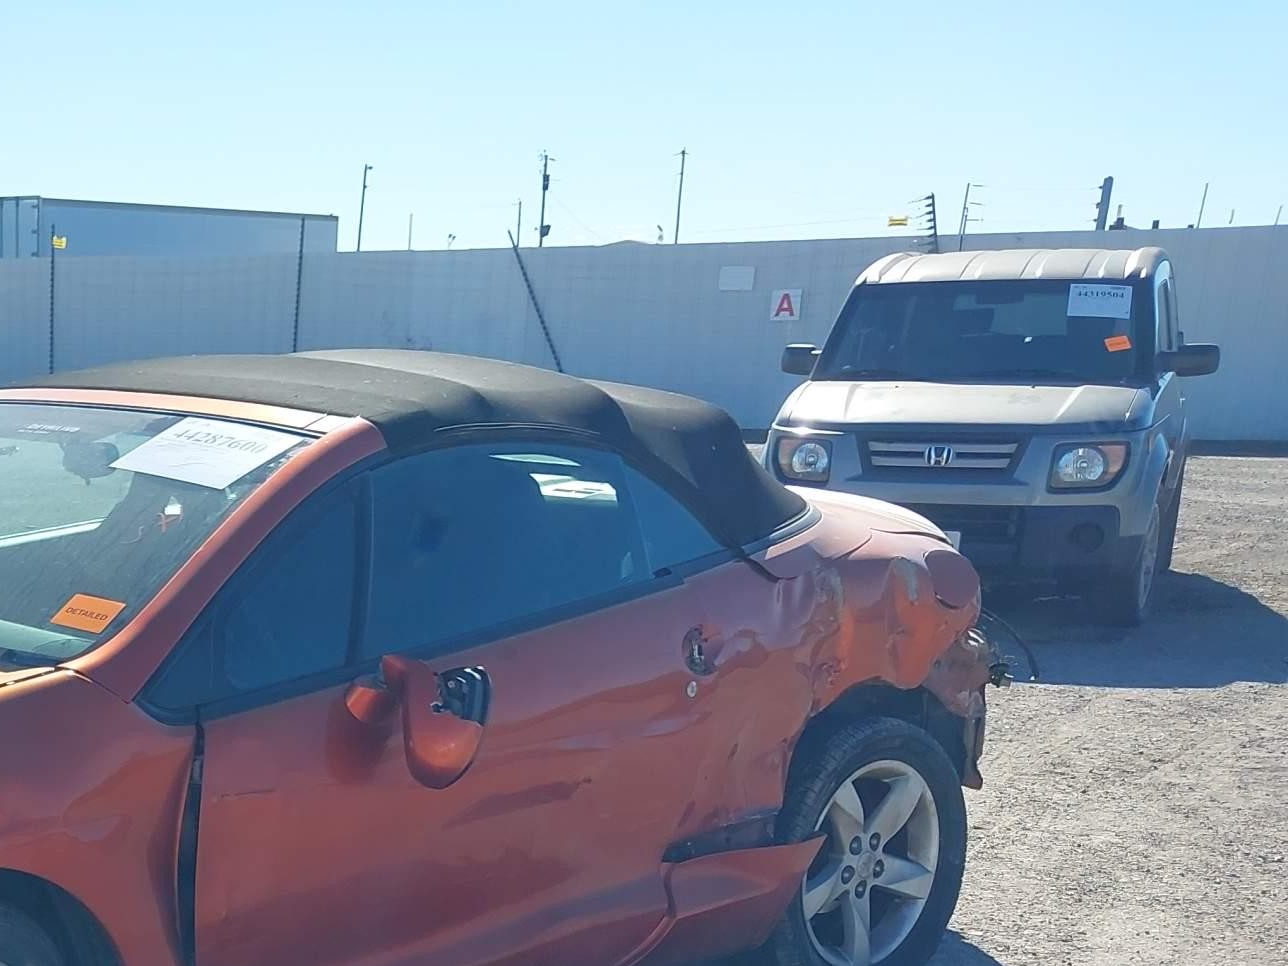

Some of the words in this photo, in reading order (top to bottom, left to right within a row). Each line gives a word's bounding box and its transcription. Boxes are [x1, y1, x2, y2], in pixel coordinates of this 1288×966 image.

[774, 293, 795, 317] A
[173, 428, 269, 454] 44287600
[65, 607, 108, 620] DETAILED
